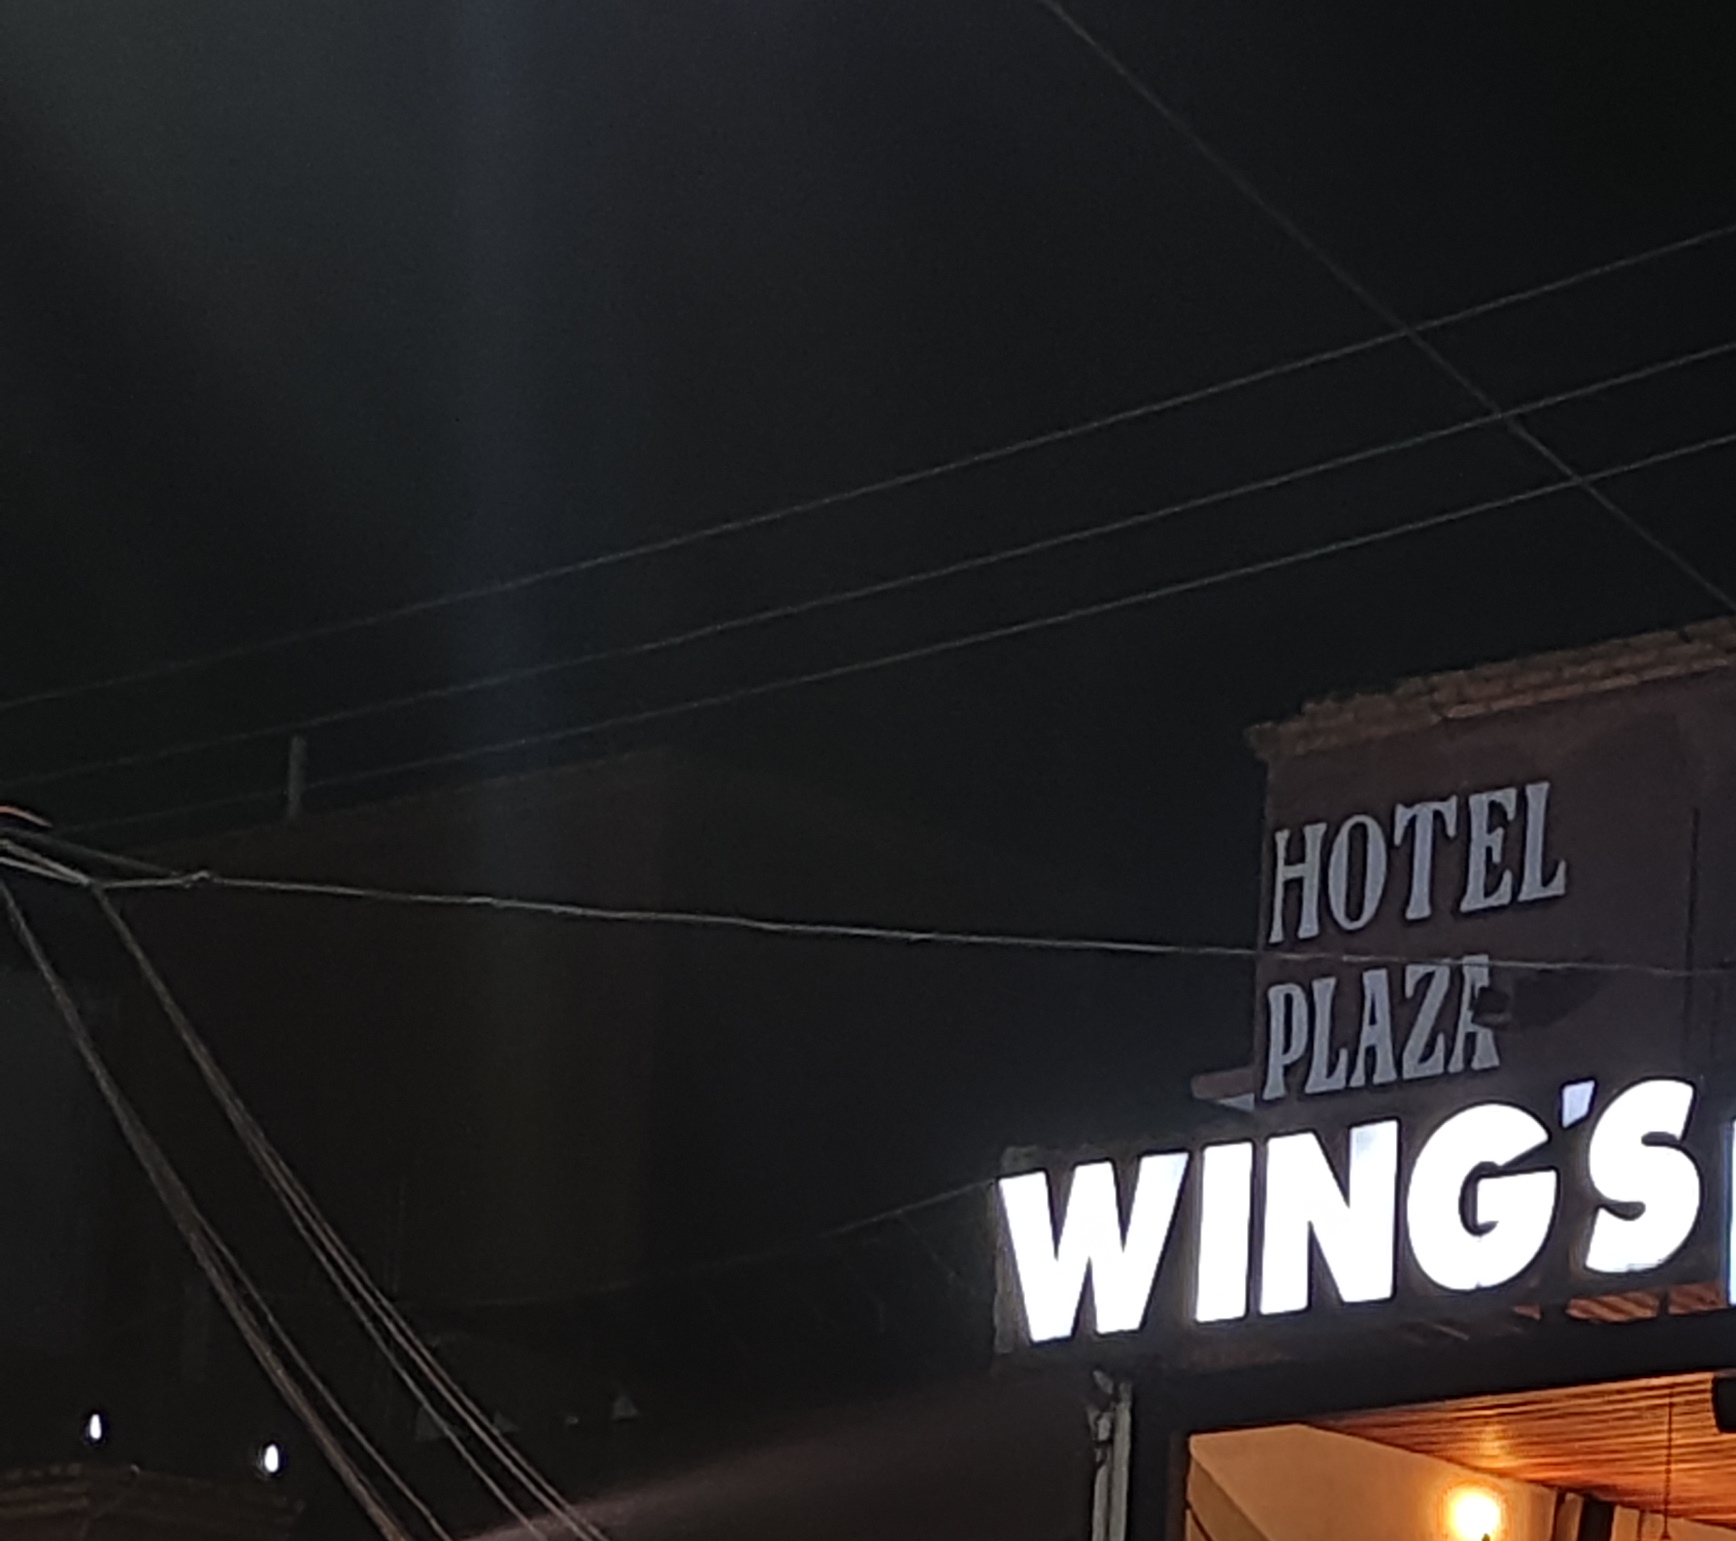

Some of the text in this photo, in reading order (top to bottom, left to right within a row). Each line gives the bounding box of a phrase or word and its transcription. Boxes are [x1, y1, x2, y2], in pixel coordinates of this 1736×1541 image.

[1267, 781, 1567, 945] HOTEL
[1261, 952, 1500, 1100] PLAZA
[998, 1078, 1702, 1344] WING'S
